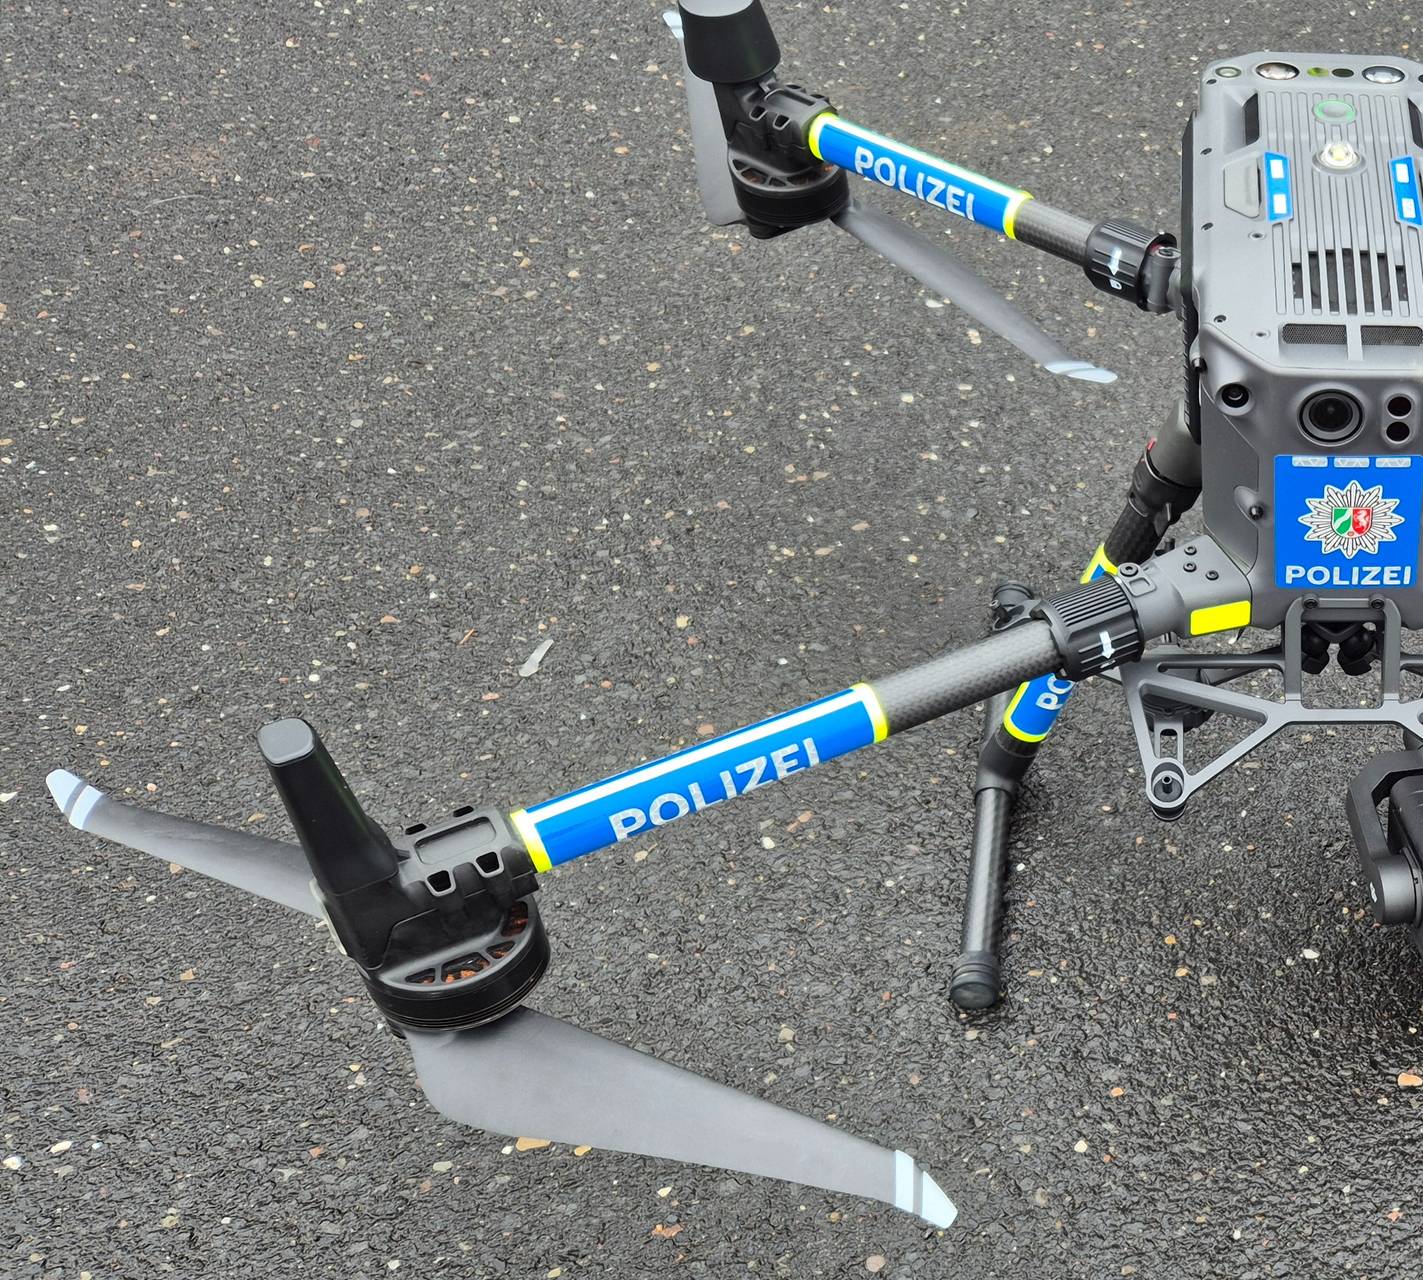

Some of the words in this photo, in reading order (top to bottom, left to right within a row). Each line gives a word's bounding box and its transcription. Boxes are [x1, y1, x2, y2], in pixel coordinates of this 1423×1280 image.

[854, 146, 975, 222] POLIZEI
[1285, 565, 1412, 586] POLIZEI
[608, 737, 821, 843] POLIZEI
